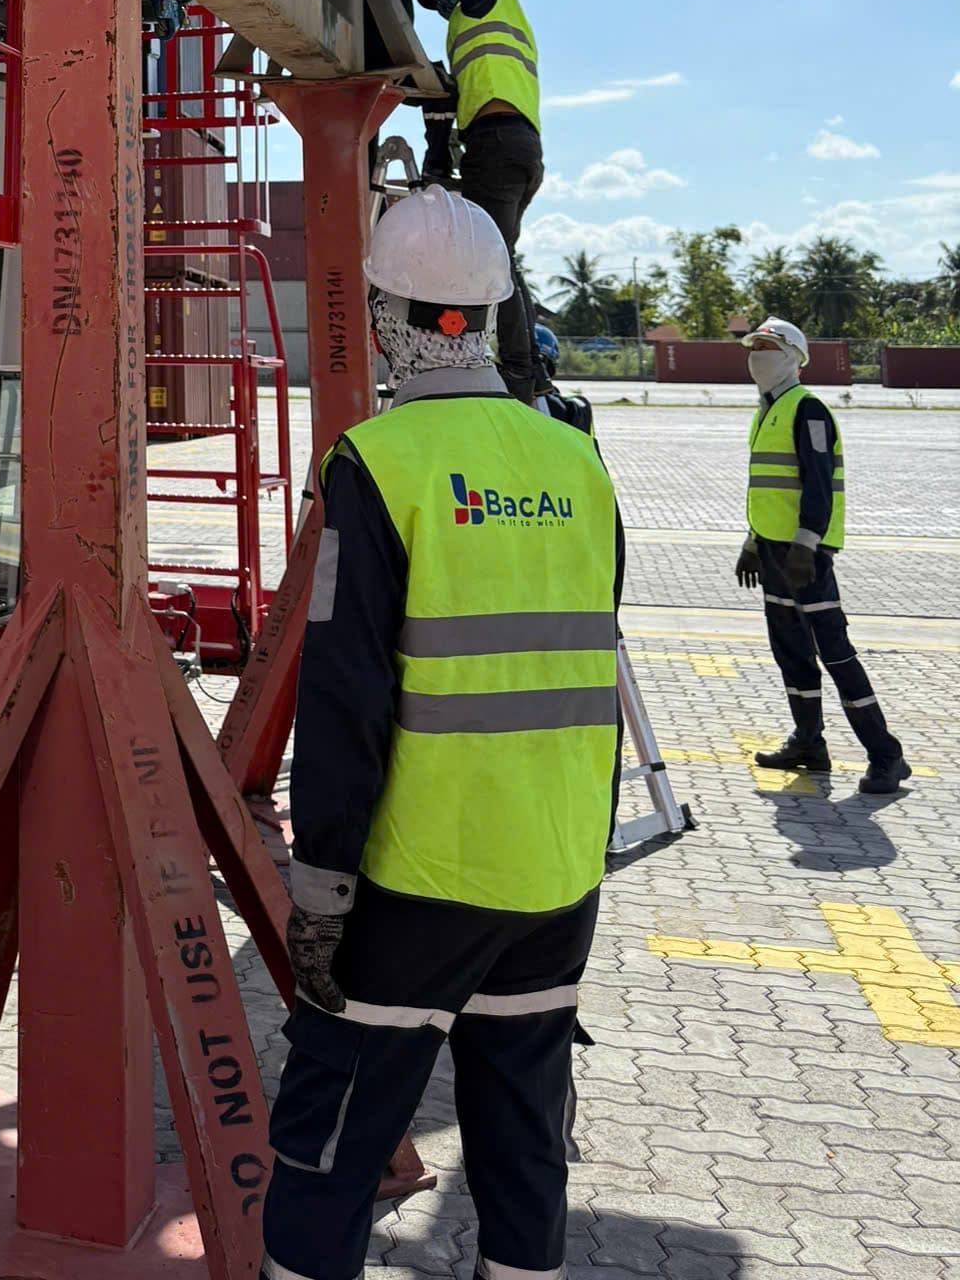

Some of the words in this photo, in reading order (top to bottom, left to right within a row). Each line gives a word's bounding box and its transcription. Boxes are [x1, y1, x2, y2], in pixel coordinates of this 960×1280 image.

[127, 324, 137, 389] FOR
[127, 406, 138, 501] ONLY
[484, 489, 573, 518] BacAu
[174, 914, 221, 1004] USE
[199, 1028, 253, 1127] NOT
